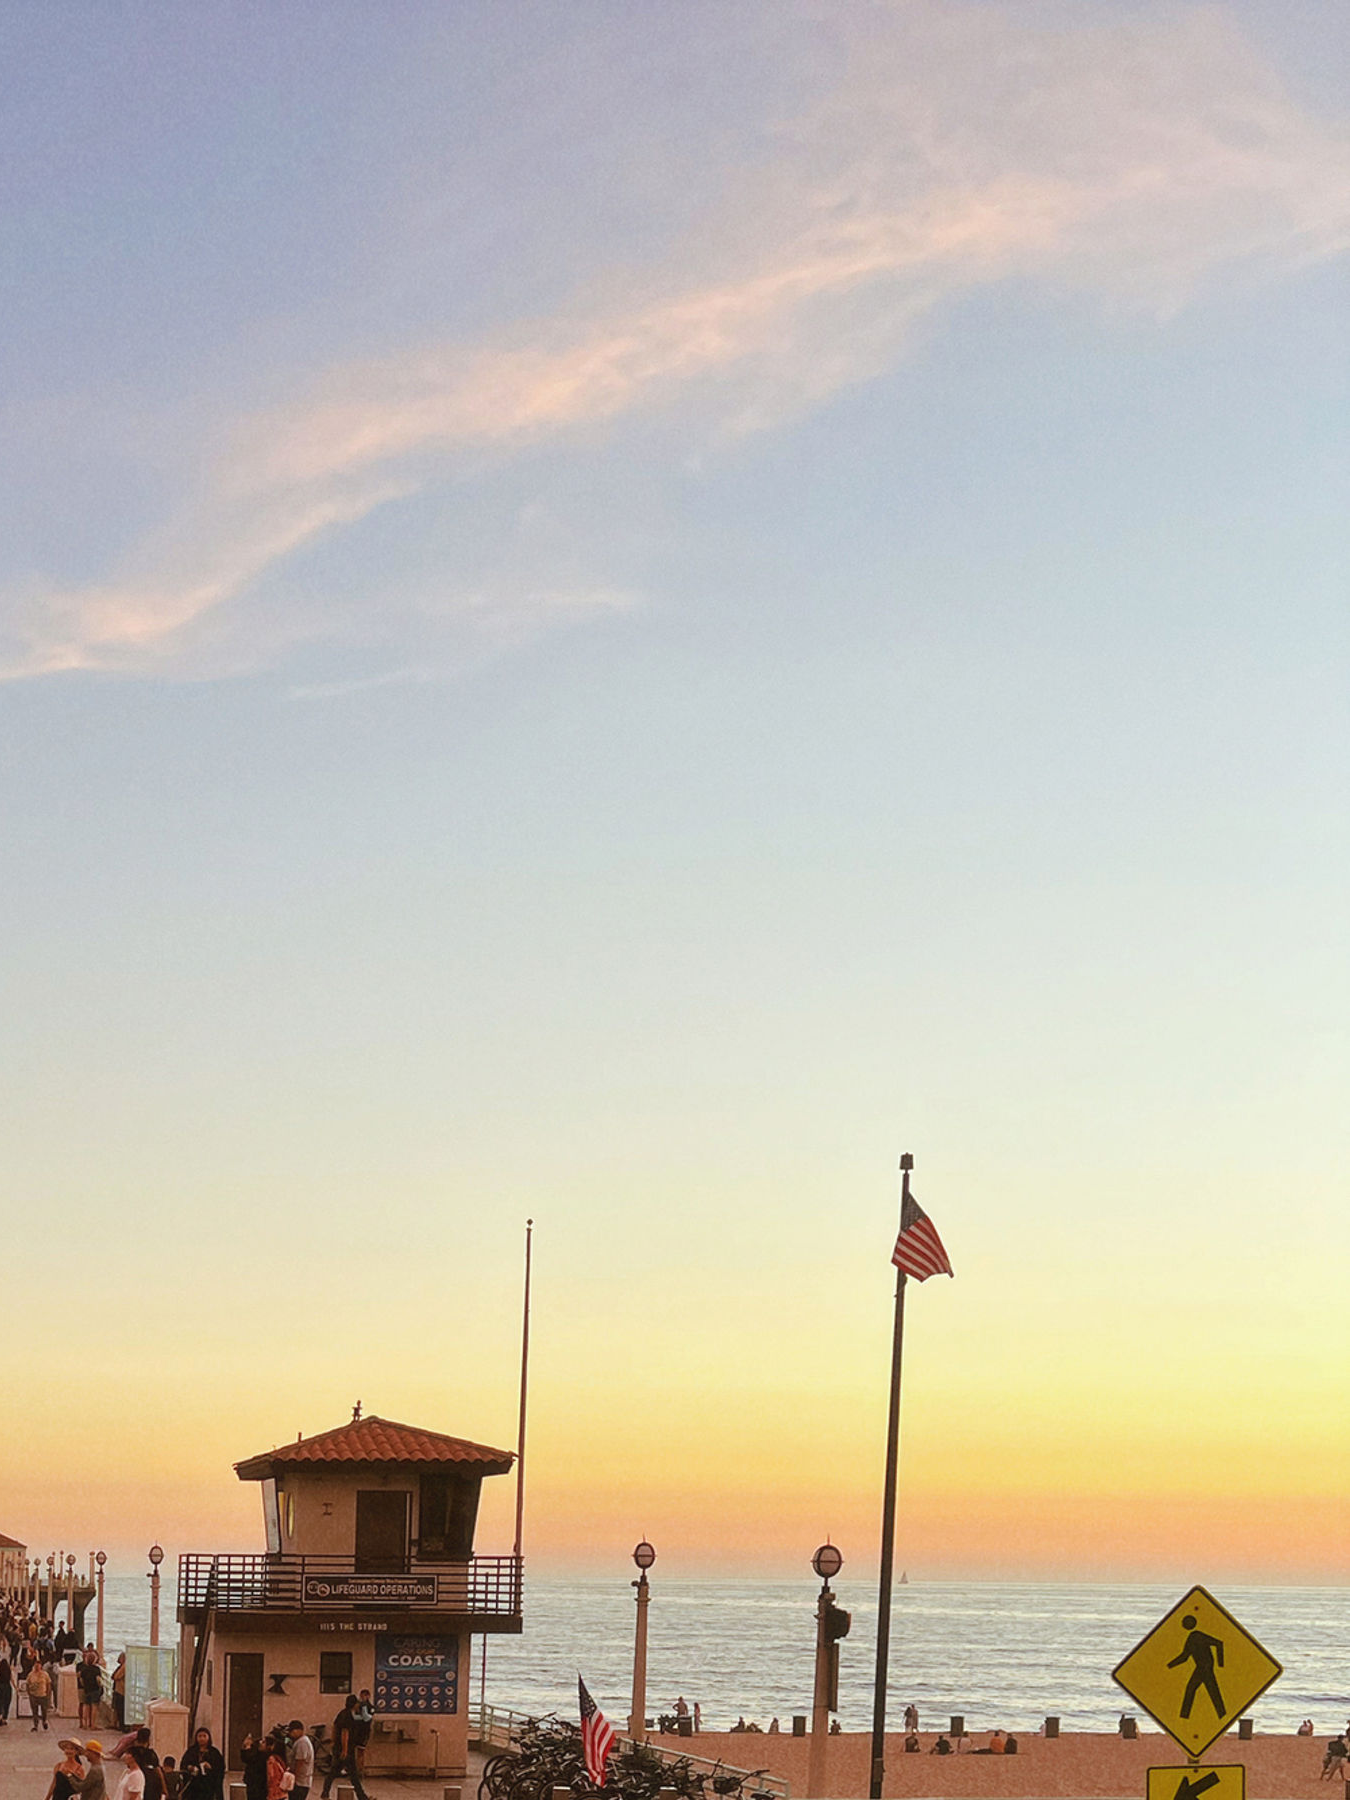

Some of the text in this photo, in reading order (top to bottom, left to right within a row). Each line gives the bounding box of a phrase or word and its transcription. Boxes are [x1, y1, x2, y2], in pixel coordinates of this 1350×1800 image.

[331, 1584, 434, 1596] LIFEGUARD OPERATIONS
[339, 1622, 355, 1631] THE
[393, 1637, 441, 1648] CARING
[388, 1654, 446, 1667] COAST
